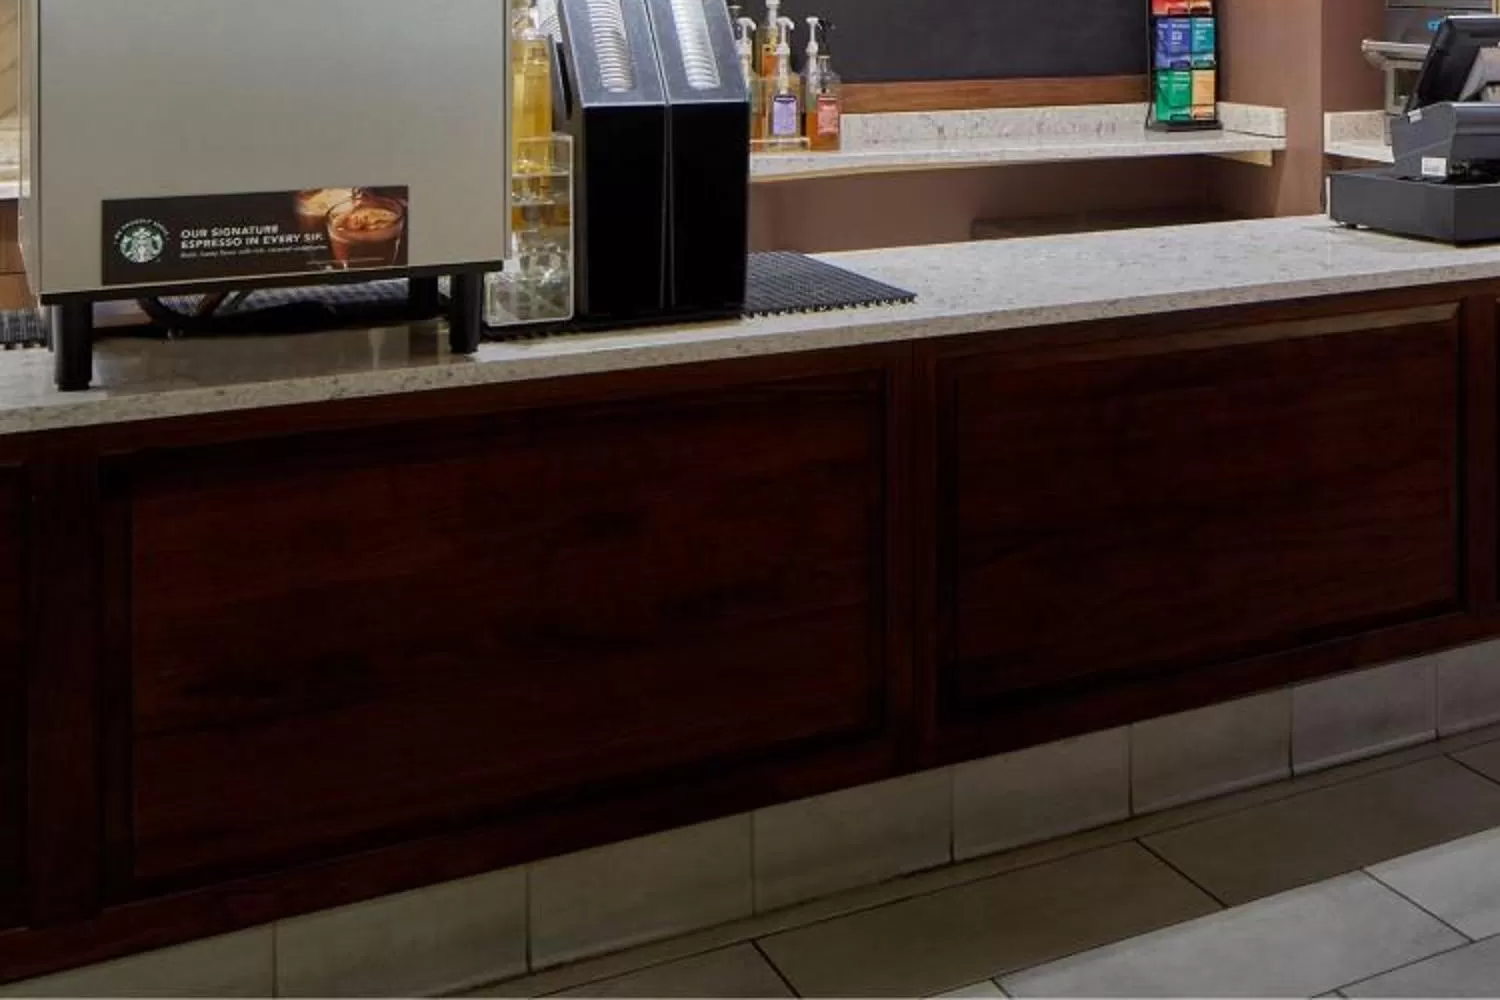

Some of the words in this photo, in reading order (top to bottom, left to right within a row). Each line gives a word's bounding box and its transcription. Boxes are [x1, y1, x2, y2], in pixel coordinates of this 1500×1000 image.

[181, 228, 209, 239] OUR
[211, 223, 279, 237] SIGNATURE
[181, 236, 243, 250] ESPRESSO
[245, 235, 260, 246] IN
[262, 232, 300, 246] EVERY
